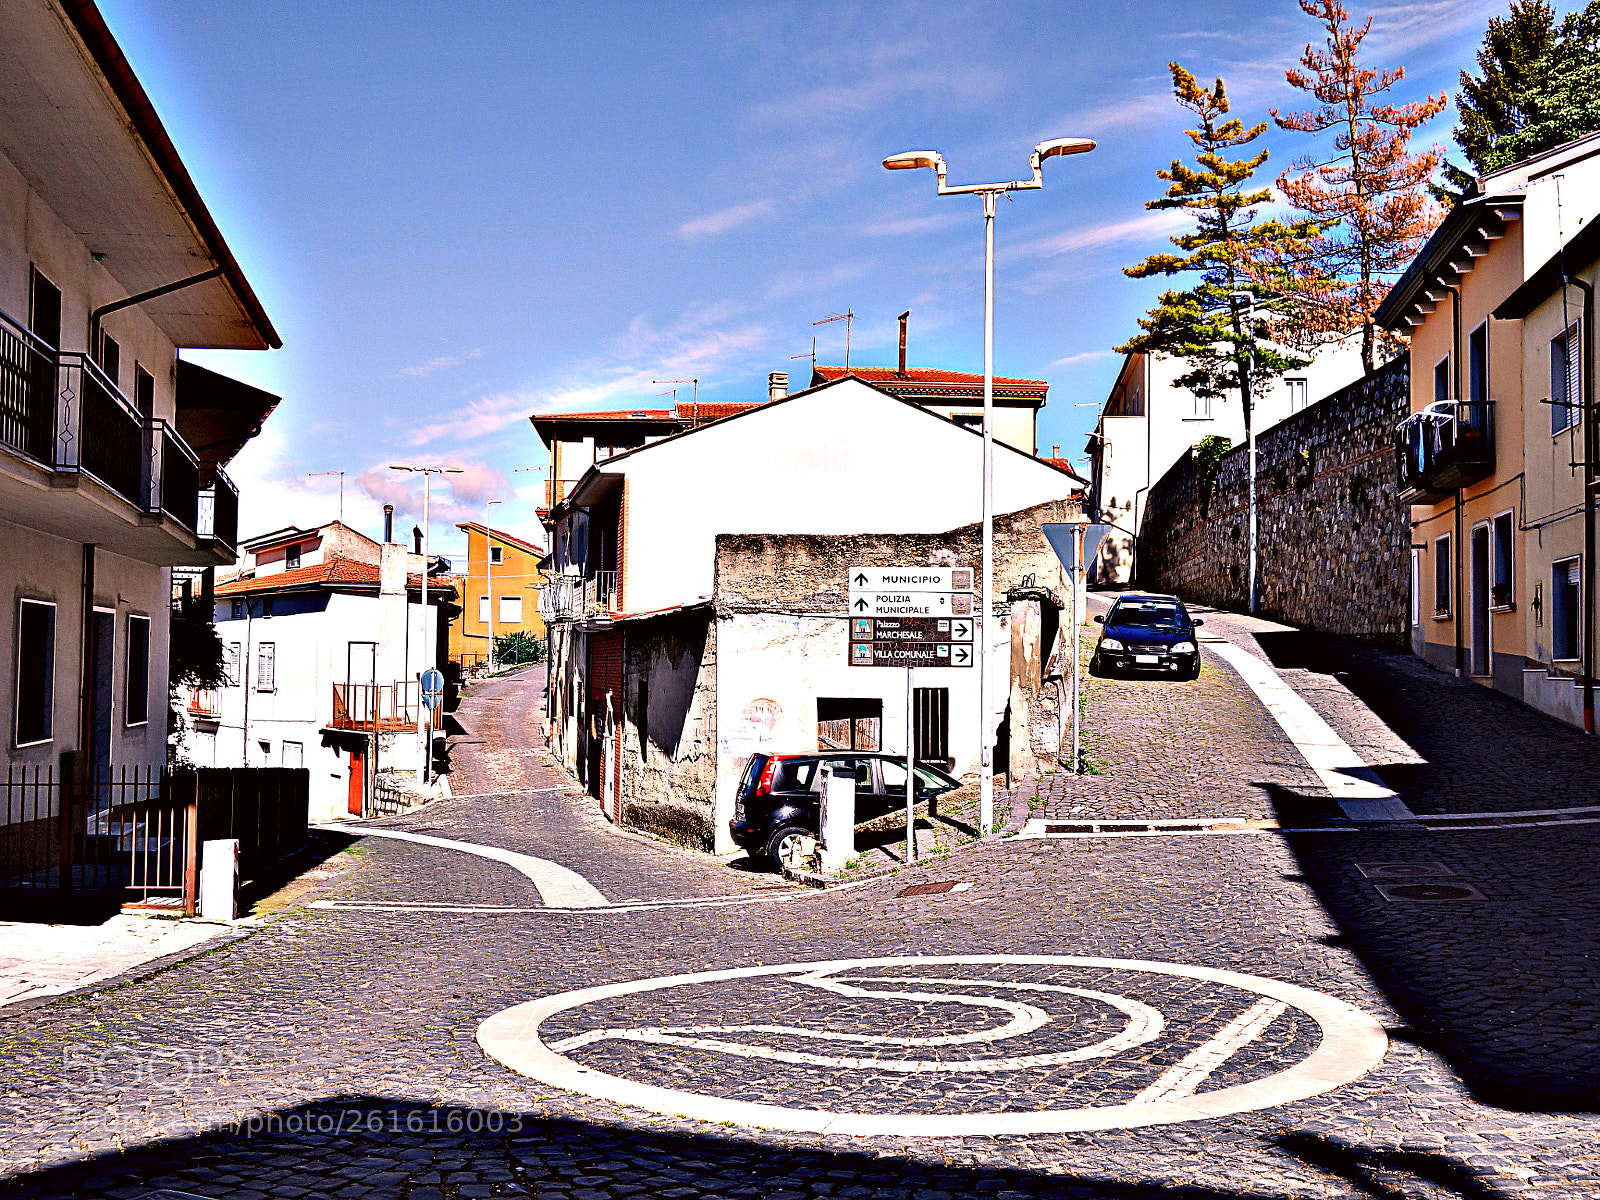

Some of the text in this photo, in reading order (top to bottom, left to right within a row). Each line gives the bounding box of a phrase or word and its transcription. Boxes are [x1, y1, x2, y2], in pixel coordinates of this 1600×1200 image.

[882, 576, 941, 584] MUNICIPIO
[876, 595, 911, 603] POLIZIA
[876, 606, 930, 614] MUNICIPALE
[876, 620, 900, 628] Palazzo
[876, 631, 923, 639] MARCHESALE
[874, 650, 935, 658] VILLA COMUNALE
